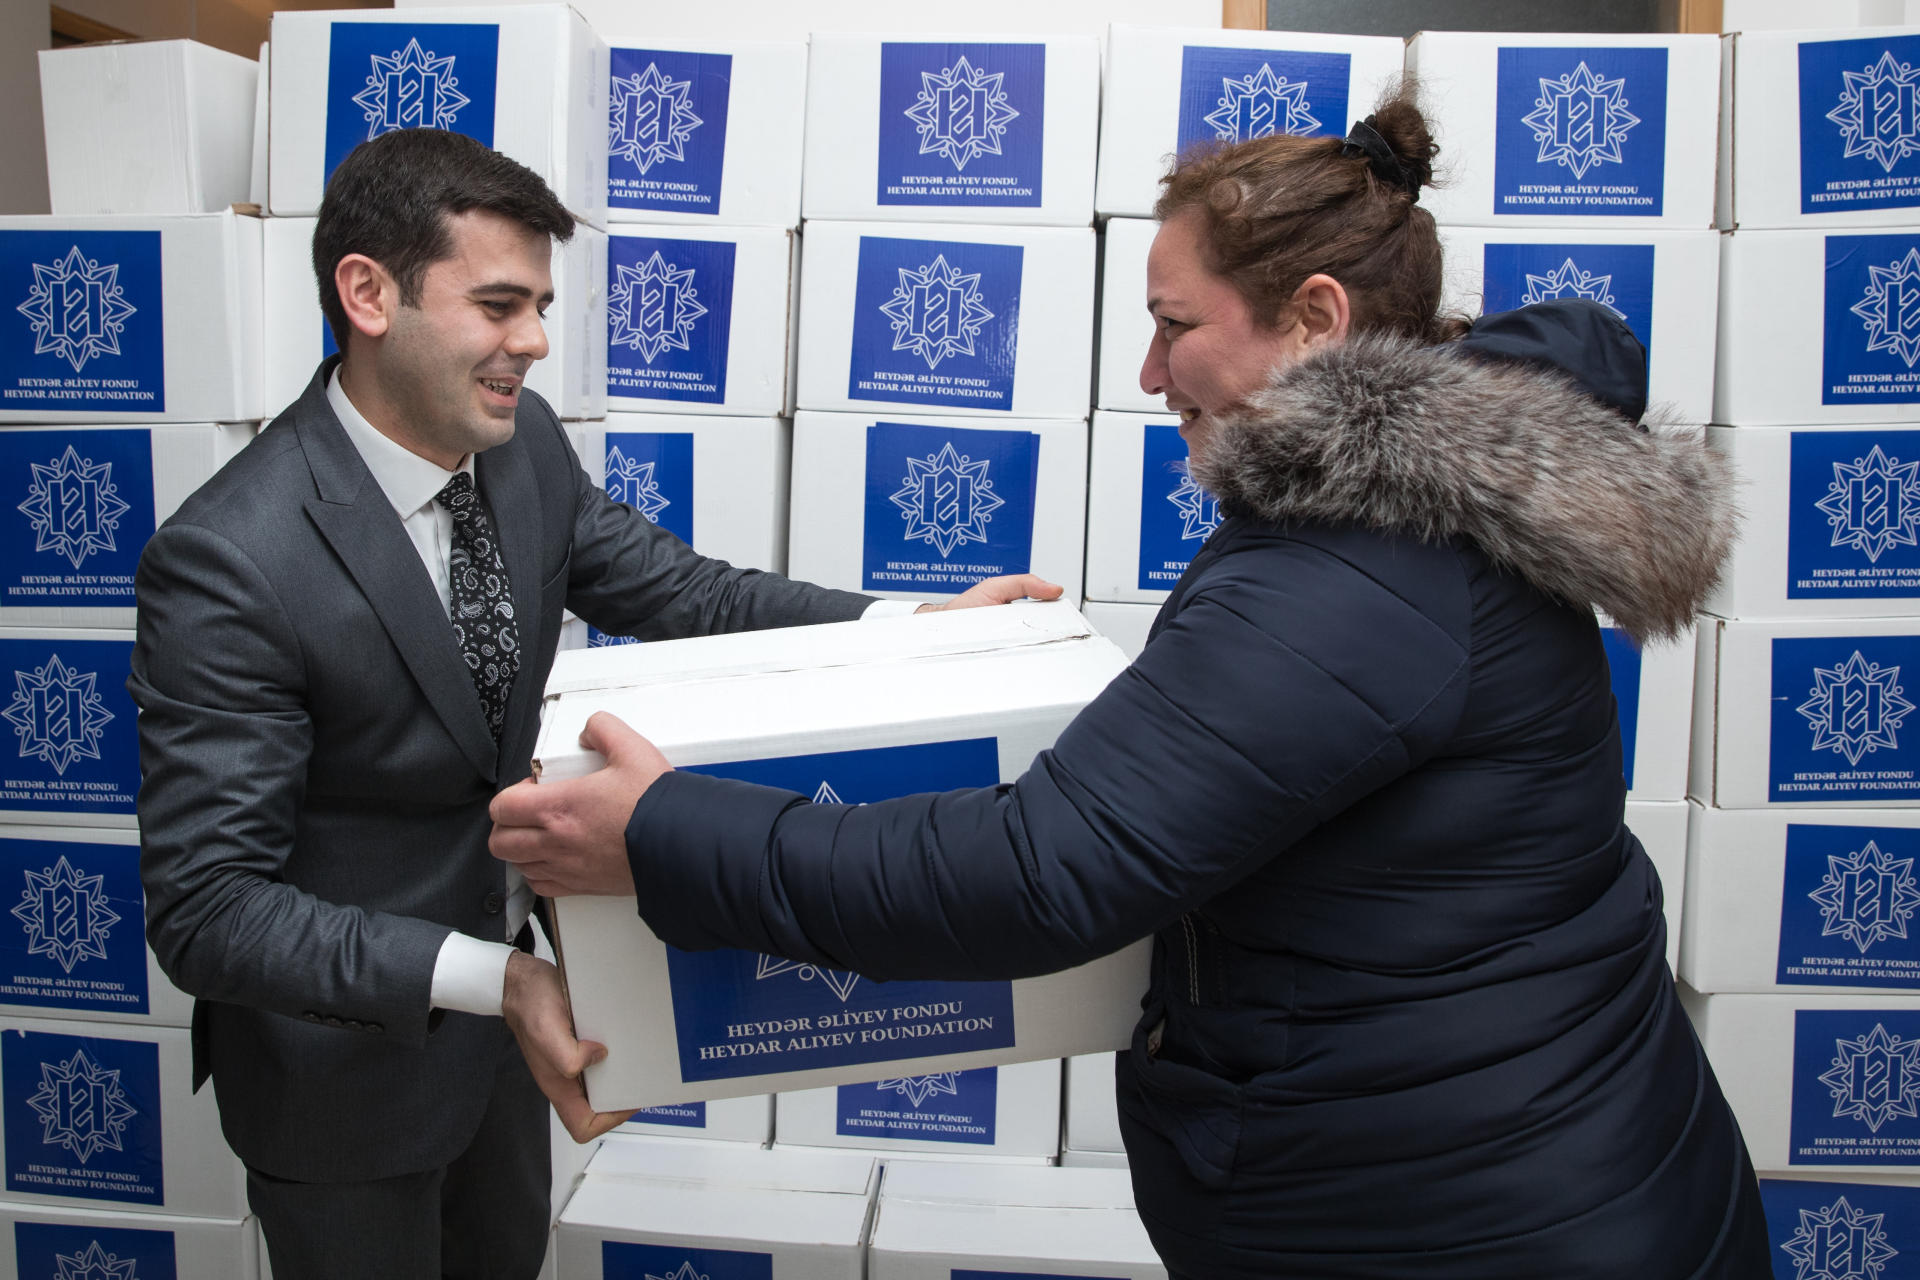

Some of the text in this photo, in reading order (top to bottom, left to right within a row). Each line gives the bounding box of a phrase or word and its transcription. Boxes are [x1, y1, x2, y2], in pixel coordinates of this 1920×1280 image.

[628, 178, 662, 189] ƏLİYEV
[664, 182, 698, 192] FONDU
[902, 175, 1018, 185] HEYDƏR ƏLİYEV FONDU
[1826, 180, 1871, 190] HEYDƏR
[1873, 176, 1911, 187] ƏLİYEV
[888, 186, 1032, 196] HEYDAR ALIYEV FOUNDATION
[1520, 184, 1638, 194] HEYDƏR ƏLİYEV FONDU
[612, 189, 645, 198] ALIYEV
[647, 191, 711, 203] FOUNDATION
[1504, 195, 1653, 205] HEYDAR ALIYEV FOUNDATION
[1811, 192, 1855, 202] HEYDAR
[1856, 189, 1893, 199] ALIYEV
[634, 368, 668, 378] ƏLİYEV
[670, 371, 703, 381] FONDU
[874, 372, 990, 387] HEYDƏR ƏLİYEV FONDU
[1848, 372, 1920, 383] HEYDƏR ƏLİY
[19, 378, 138, 388] HEYDƏR ƏLİYEV FONDU
[618, 378, 651, 388] ALIYEV
[653, 380, 716, 392] FOUNDATION
[858, 381, 1003, 399] HEYDAR ALIYEV FOUNDATION
[1832, 385, 1875, 394] HEYDAR
[1877, 384, 1914, 393] ALIYEV
[4, 390, 154, 400] HEYDAR ALIYEV FOUNDATION
[887, 562, 1003, 574] HEYDƏR ƏLİYEV FONDU
[1813, 569, 1856, 577] HEYDƏR
[1858, 567, 1894, 577] ƏLİYEV
[22, 574, 135, 584] HEYDƏR ƏLİYEV FONDU
[872, 572, 912, 581] HEYDAR
[914, 573, 949, 582] ALIYEV
[1798, 580, 1839, 588] HEYDAR
[1841, 579, 1877, 588] ALIYEV
[8, 587, 135, 595] HEYDAR ALIYEV FOUNDATI
[1794, 770, 1914, 781] HEYDƏR ƏLİYEV FONDU
[5, 780, 118, 791] HEYDƏR ƏLİYEV FONDU
[1779, 781, 1920, 792] HEYDAR ALIYEV FOUNDATIO
[0, 791, 134, 803] EYDAR ALIYEV FOUNDATION
[1803, 957, 1845, 966] HEYDƏR
[1847, 957, 1884, 967] ƏLİYEV
[1787, 966, 1828, 976] HEYDAR
[1830, 968, 1866, 977] ALIYEV
[14, 976, 124, 991] HEYDƏR ƏLİYEV FONDU
[40, 988, 73, 998] ALIYEV
[75, 991, 139, 1003] FOUNDATION
[727, 1001, 963, 1038] HEYDƏR ƏLİYEV FONDU
[700, 1017, 994, 1060] HEYDAR ALIYEV FOUNDATION
[641, 1107, 696, 1117] OUNDATION
[860, 1109, 972, 1124] HEYDƏR ƏLİYEV FONDU
[846, 1118, 986, 1134] HEYDAR ALIYEV FOUNDATION
[1814, 1137, 1856, 1146] HEYDƏR
[1859, 1136, 1895, 1146] ƏLİYEV
[1799, 1147, 1840, 1156] HEYDAR
[1842, 1147, 1877, 1156] ALIYEV
[28, 1164, 140, 1182] HEYDƏR ƏLİYEV FONDU
[15, 1173, 154, 1194] HEYDAR ALIYEV FOUNDATION
